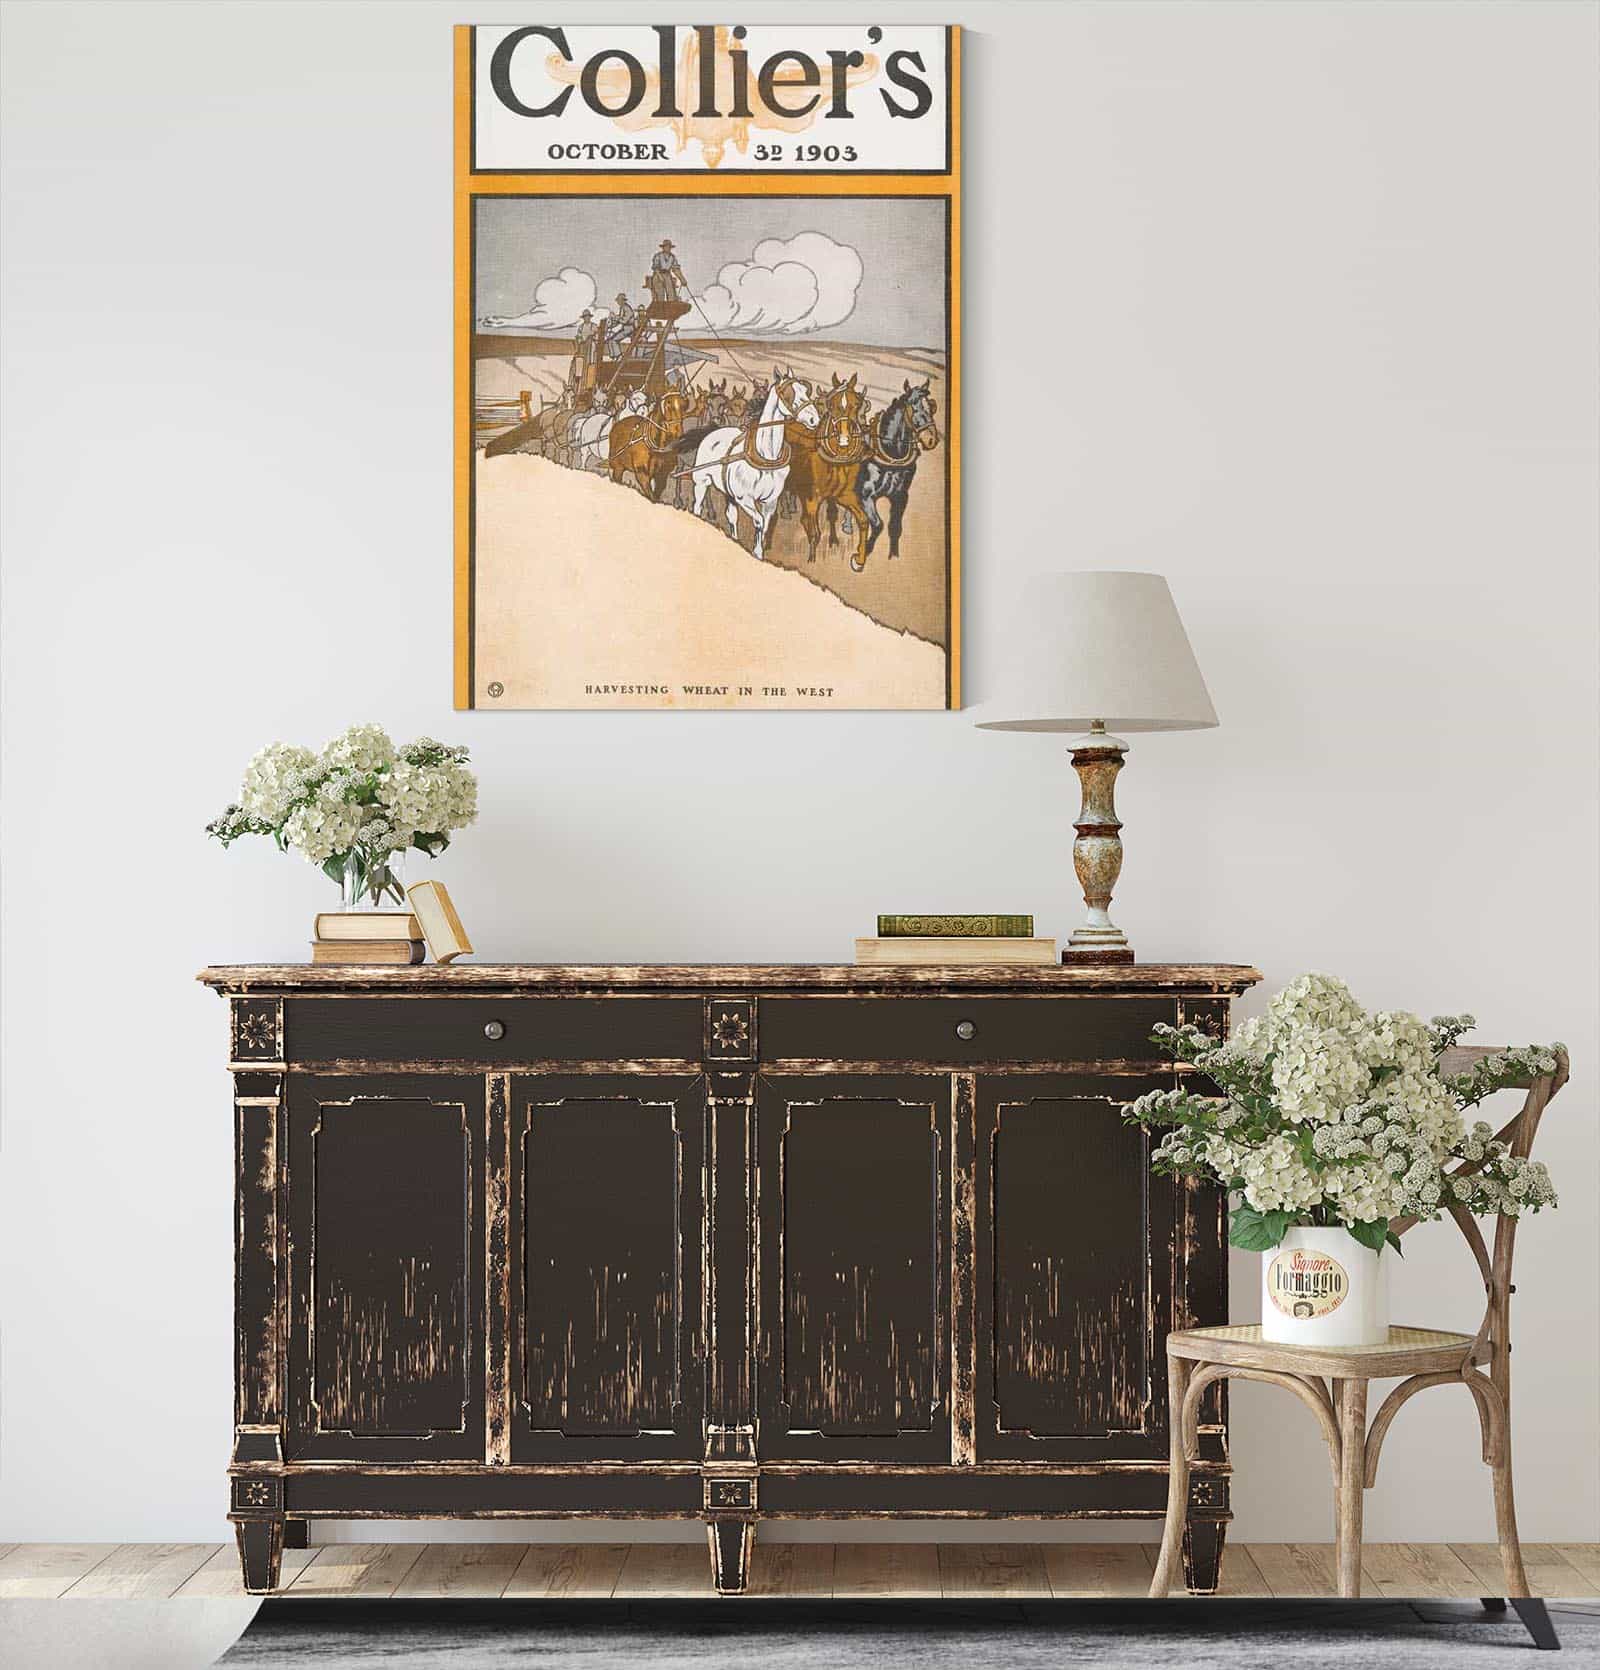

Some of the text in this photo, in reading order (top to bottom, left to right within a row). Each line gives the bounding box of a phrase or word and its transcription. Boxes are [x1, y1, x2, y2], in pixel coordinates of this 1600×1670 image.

[490, 25, 933, 119] Collier's
[547, 143, 670, 161] OCTOBER
[795, 145, 858, 162] 1903
[584, 685, 834, 697] HARVESTING WHEAT IN THE WEST
[1291, 1252, 1330, 1274] Signore
[1276, 1263, 1342, 1299] Formaggio
